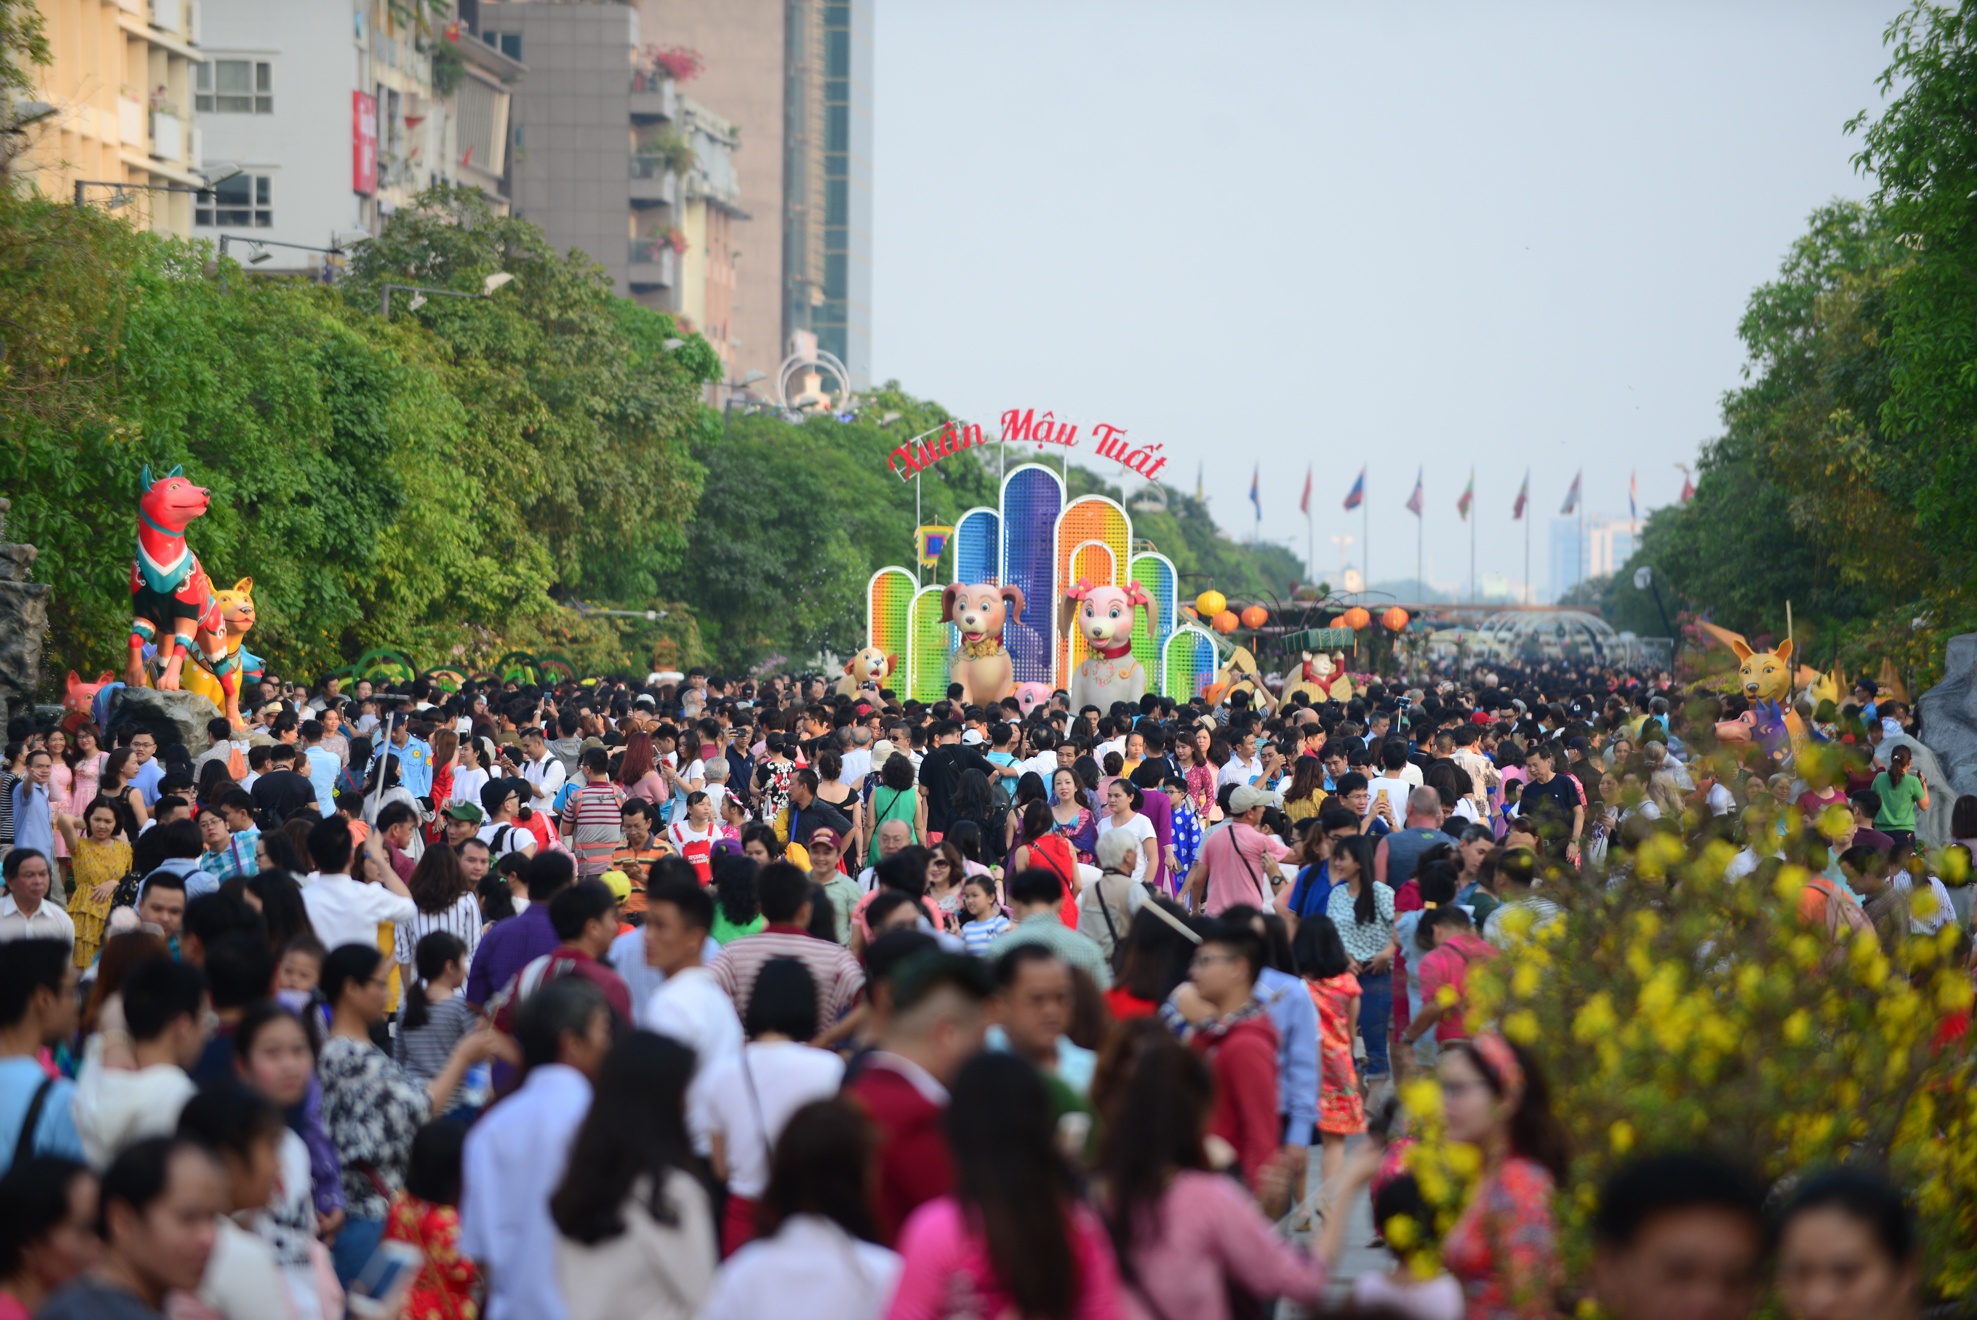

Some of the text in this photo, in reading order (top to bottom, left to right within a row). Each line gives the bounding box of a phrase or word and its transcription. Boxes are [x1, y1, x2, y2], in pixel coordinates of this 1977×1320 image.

[888, 408, 1167, 481] Xuân Mậu Tuất
